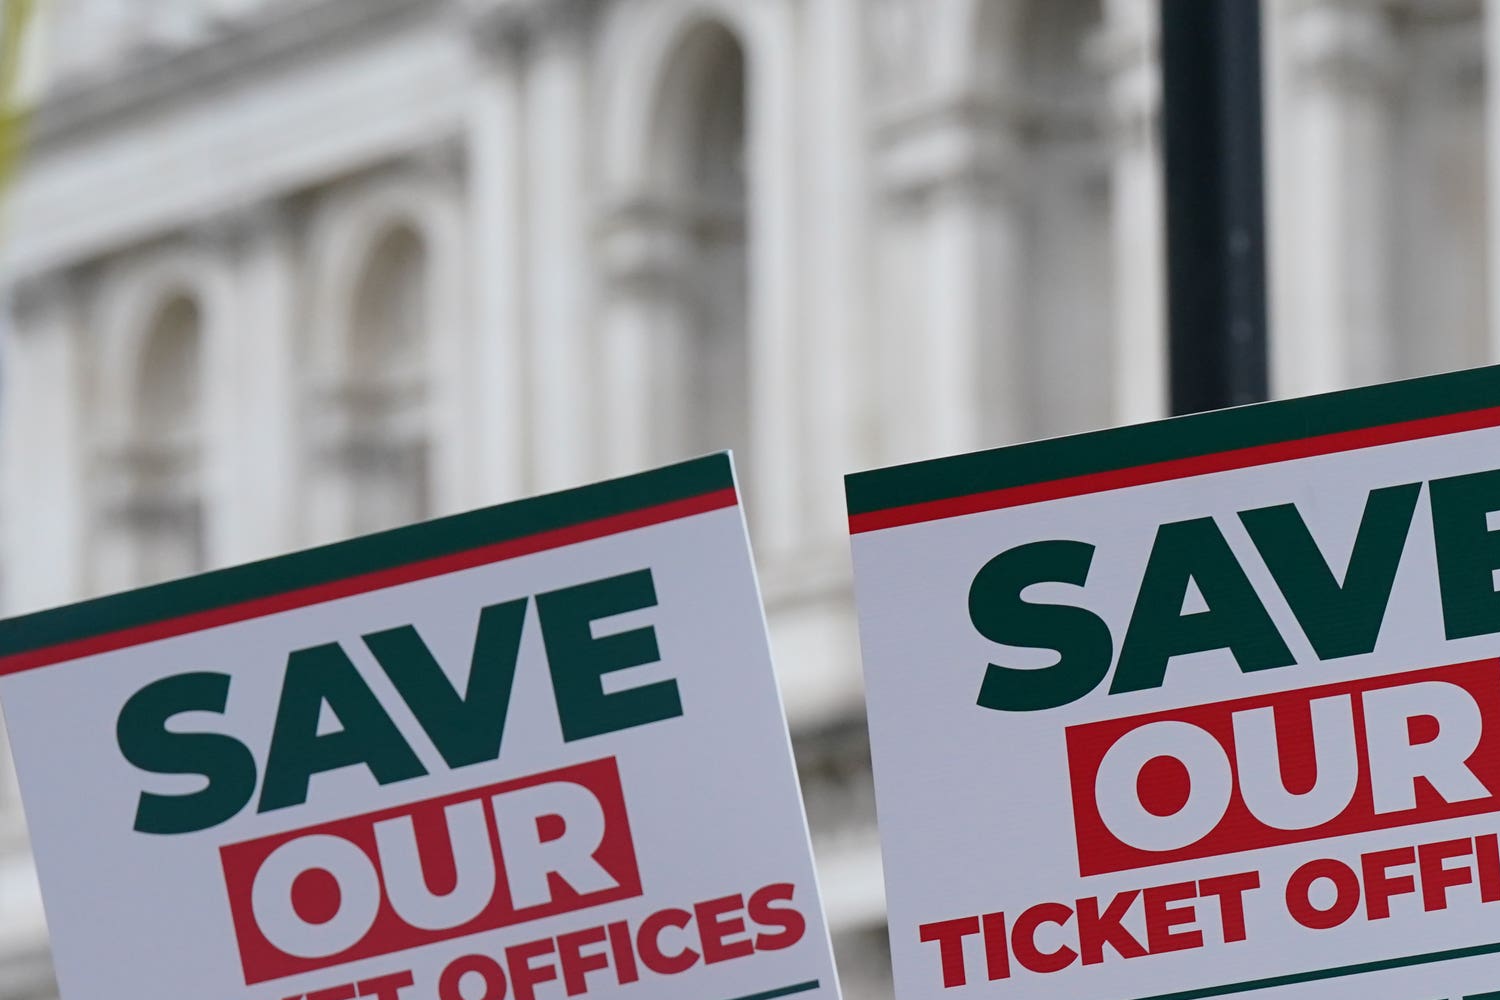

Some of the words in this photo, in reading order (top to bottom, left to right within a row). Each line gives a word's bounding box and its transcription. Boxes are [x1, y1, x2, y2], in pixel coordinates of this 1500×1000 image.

[117, 568, 683, 834] SAVE
[1095, 681, 1492, 851] OUR
[252, 782, 619, 958] OUR
[920, 871, 1260, 988] TICKET
